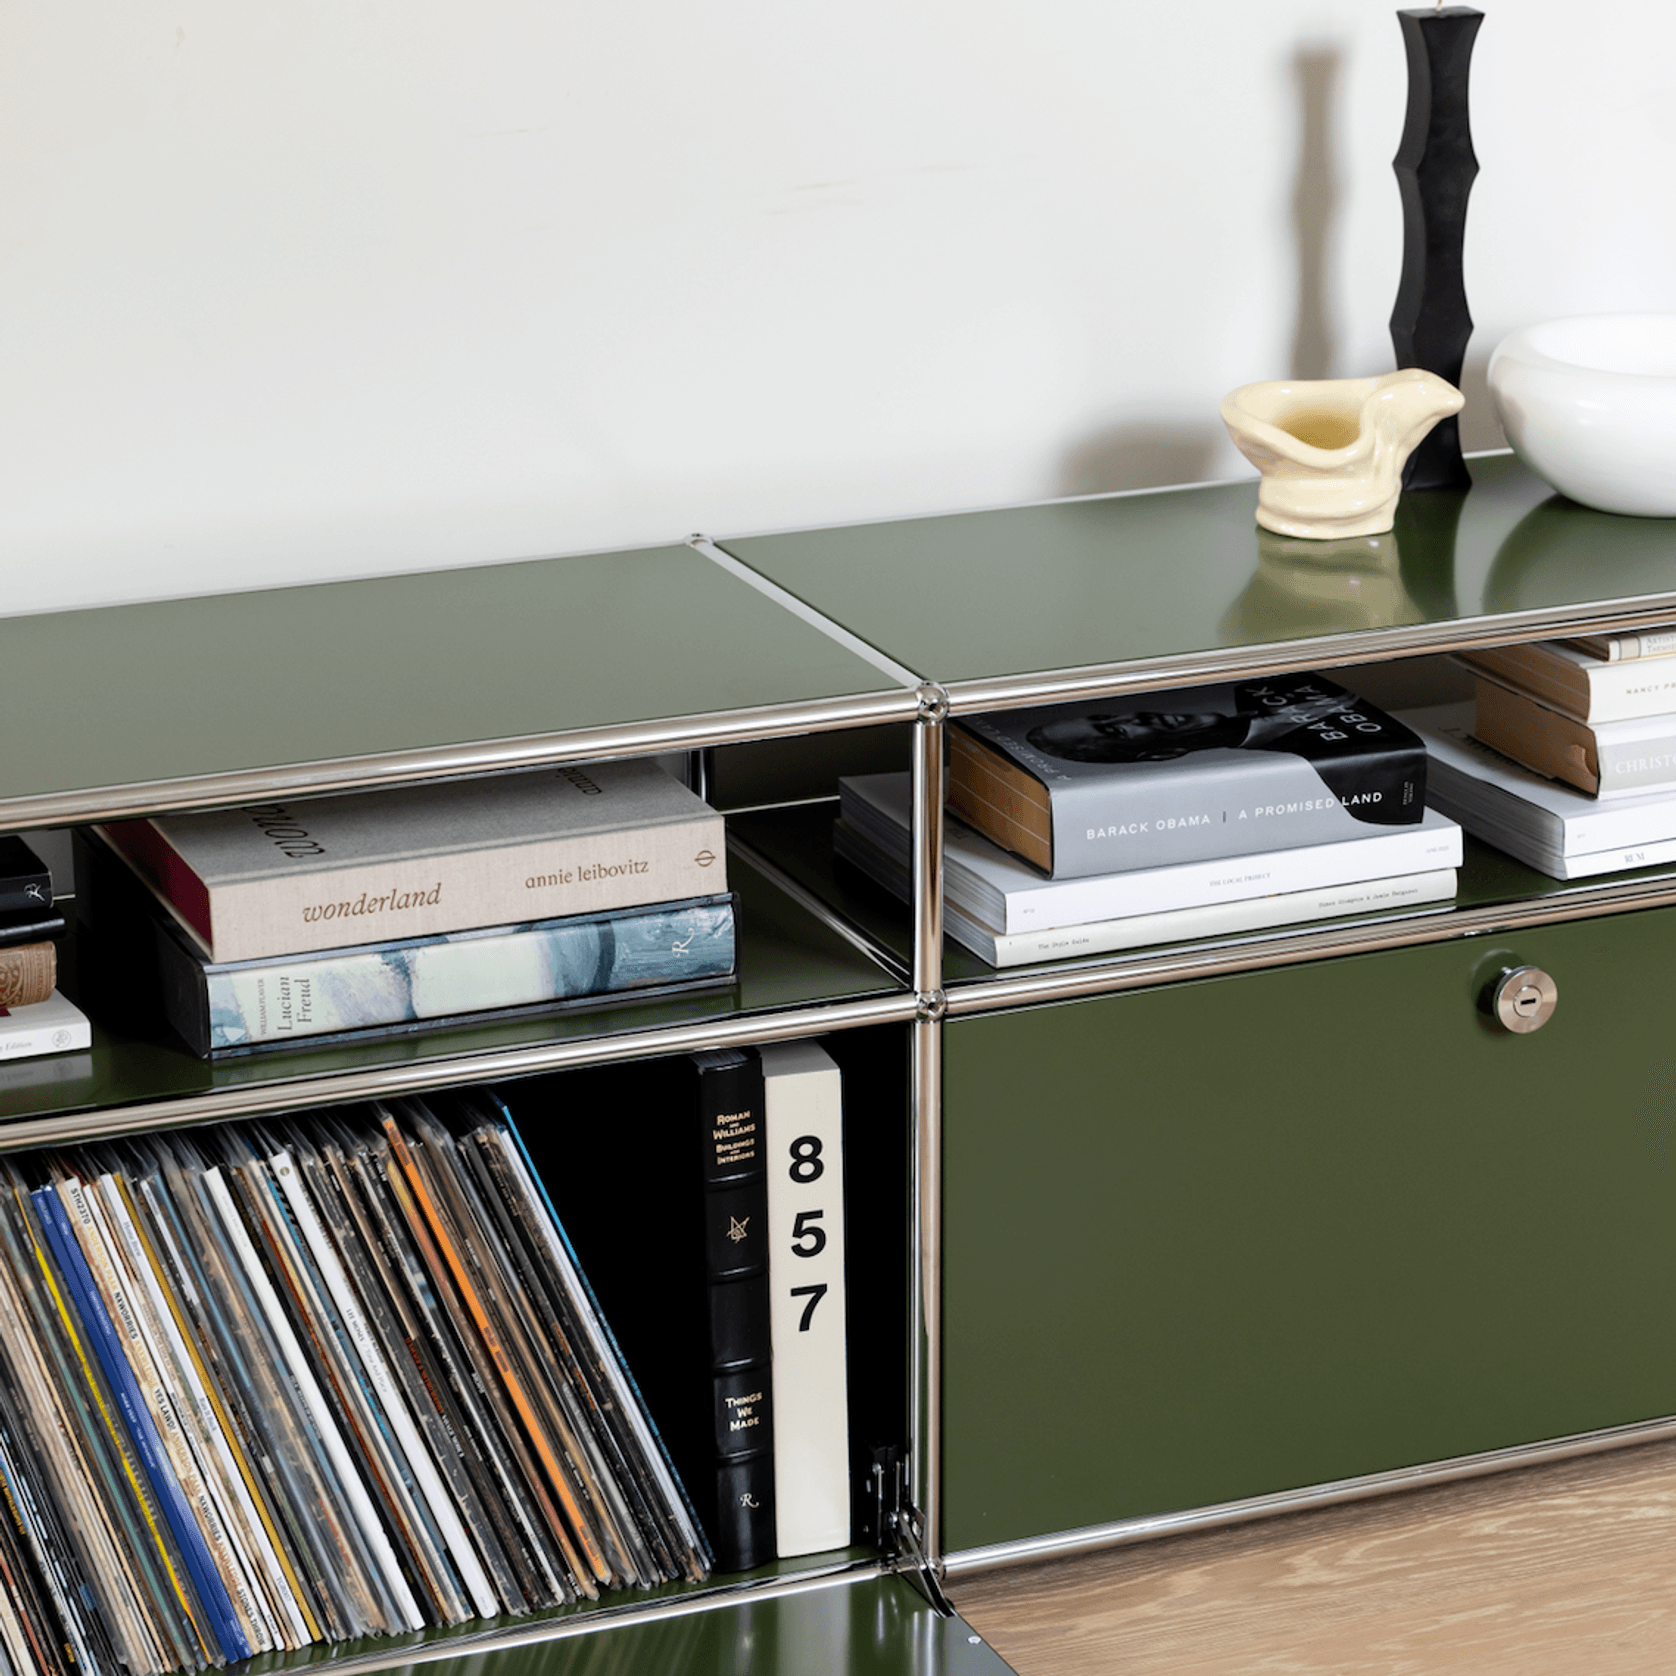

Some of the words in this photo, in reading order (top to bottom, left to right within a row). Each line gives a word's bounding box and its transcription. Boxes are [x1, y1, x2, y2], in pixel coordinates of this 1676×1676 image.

[1626, 685, 1659, 695] NANCY
[1245, 686, 1348, 741] BARACK
[1294, 685, 1382, 733] OBAMA
[1086, 821, 1149, 840] BARACK
[1156, 814, 1211, 831] OBAMA
[1238, 809, 1248, 820] A
[1254, 797, 1335, 818] PROMISED
[1341, 791, 1383, 807] LAND
[525, 869, 573, 889] annie
[578, 859, 649, 882] leibovitz
[302, 882, 442, 922] wonderland
[277, 977, 292, 1031] Lucian
[294, 979, 312, 1022] Freud
[713, 1123, 756, 1140] WILLIAMS
[716, 1110, 750, 1126] ROMAN
[725, 1392, 762, 1408] THINGS
[737, 1407, 752, 1418] WE
[730, 1416, 759, 1432] MADE
[155, 1388, 166, 1406] YES
[237, 1588, 255, 1618] STONES
[250, 1617, 266, 1645] THROW
